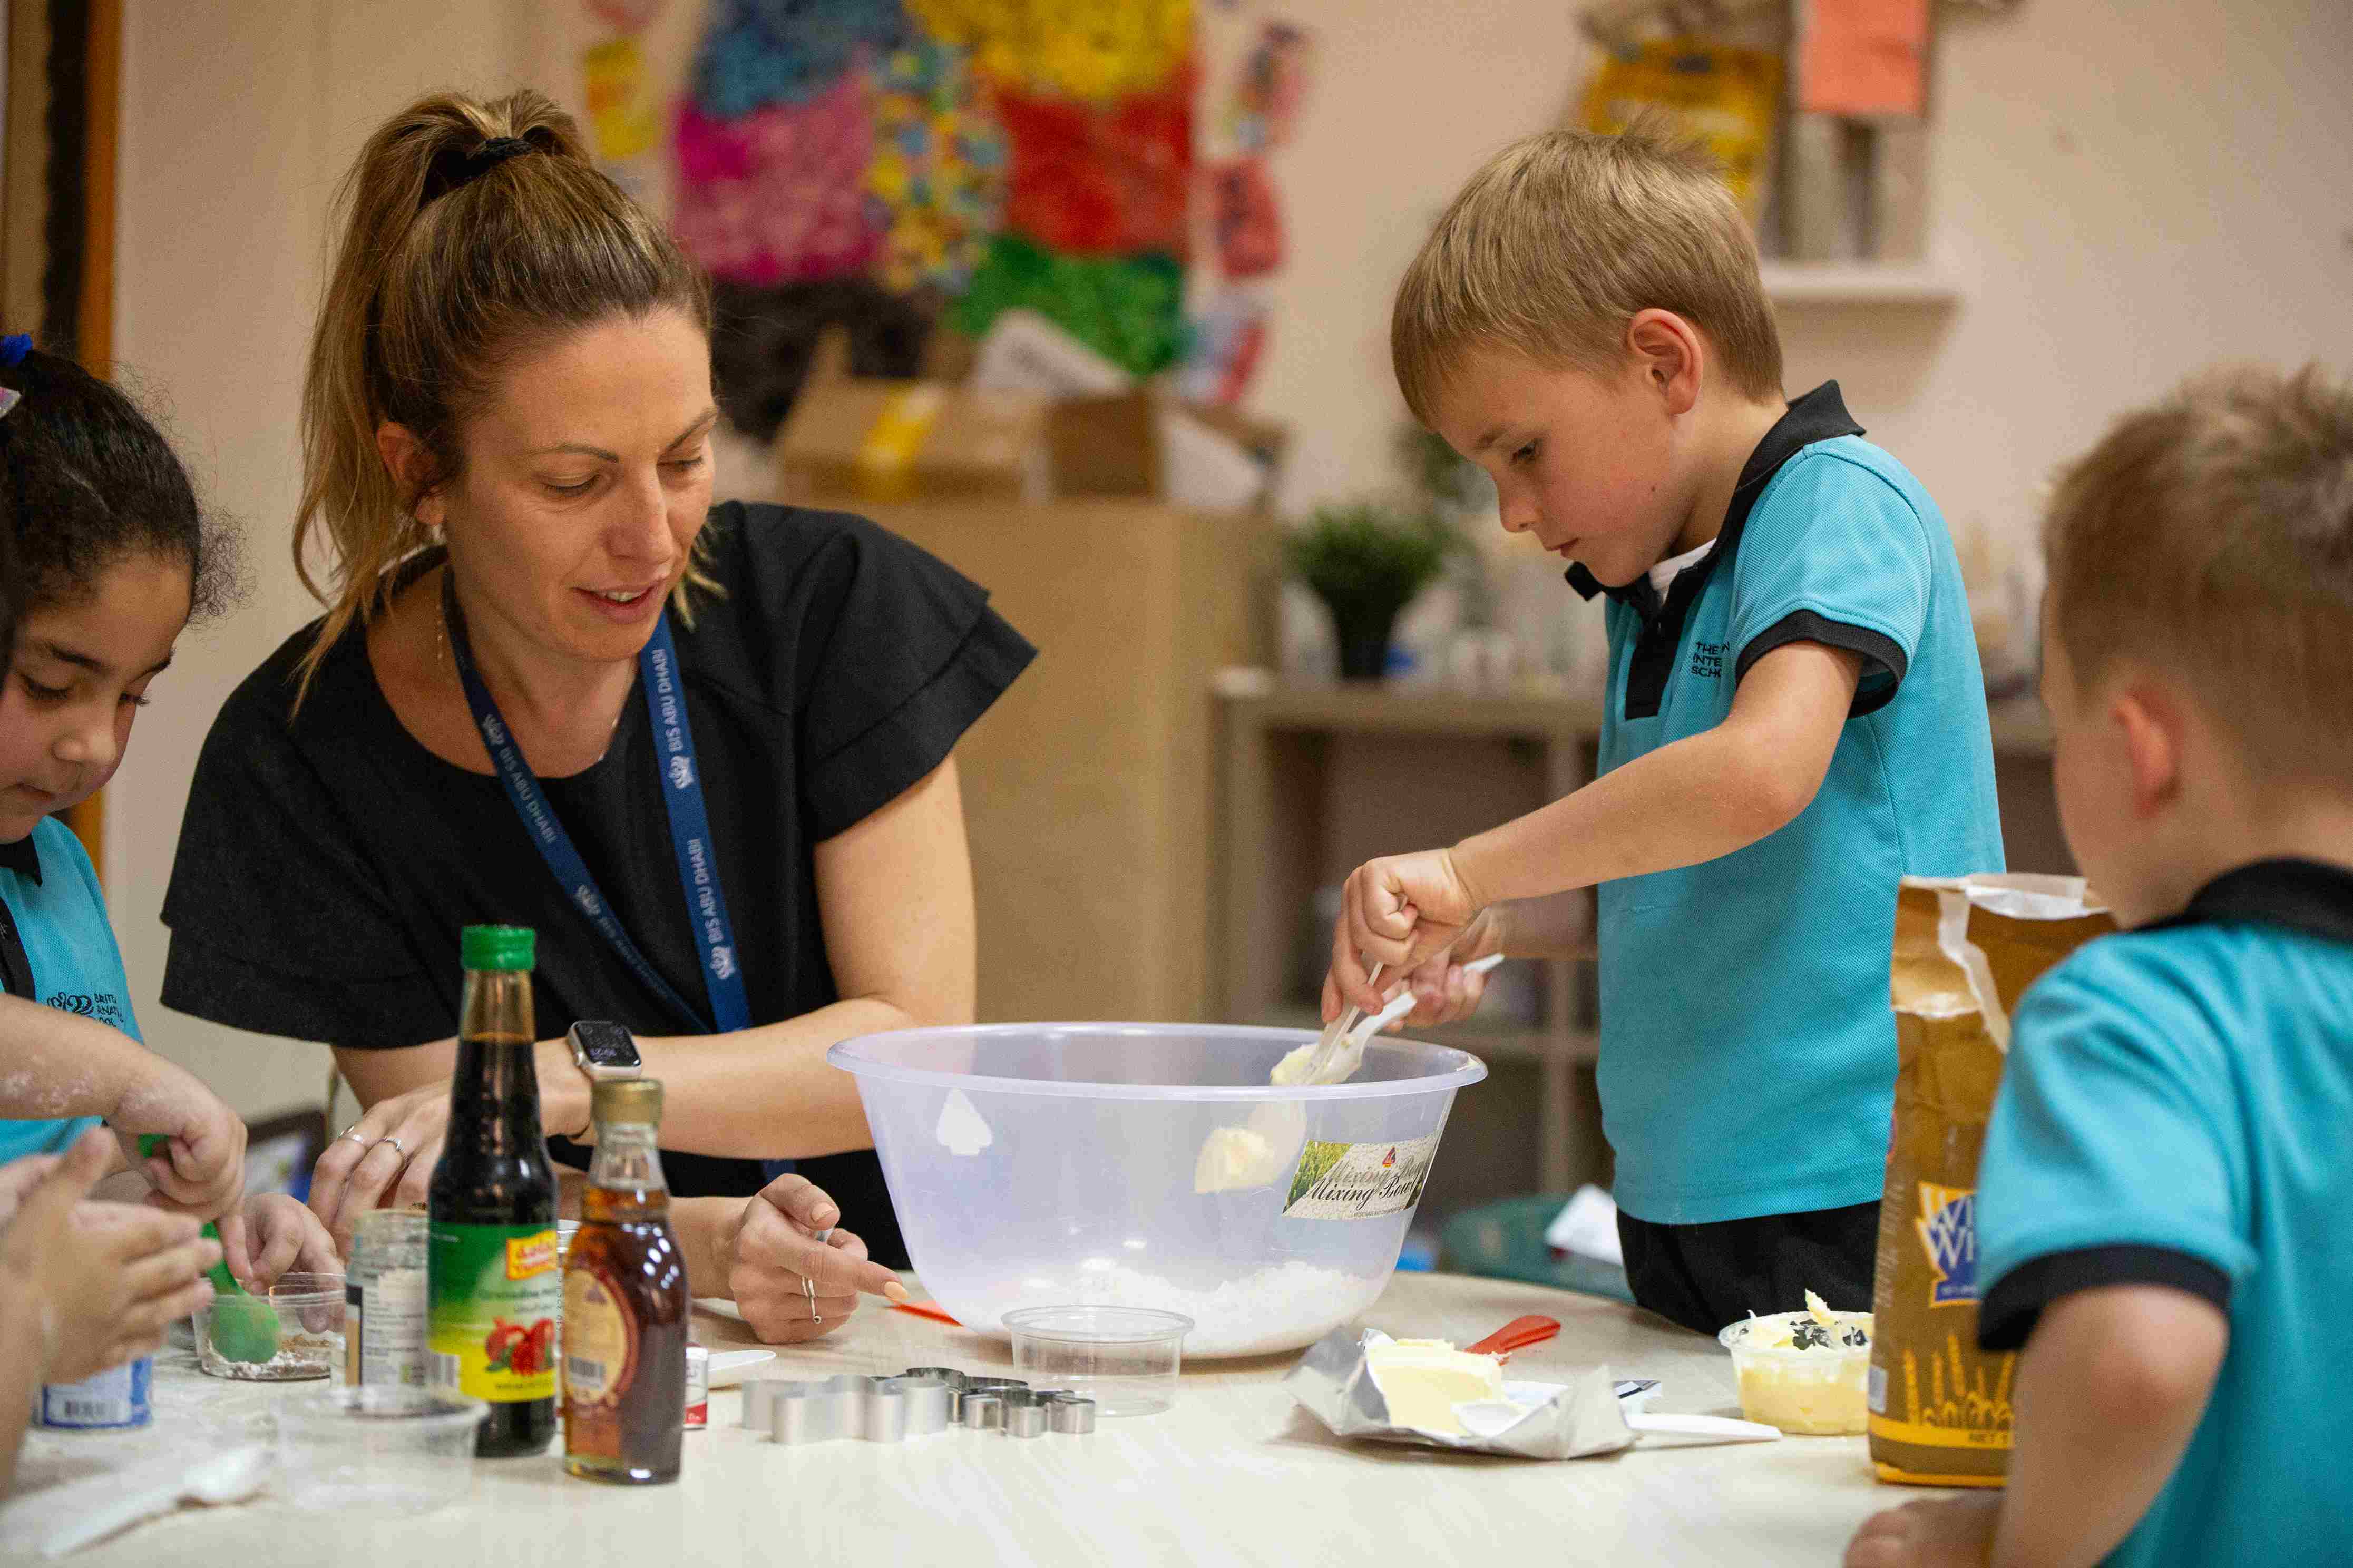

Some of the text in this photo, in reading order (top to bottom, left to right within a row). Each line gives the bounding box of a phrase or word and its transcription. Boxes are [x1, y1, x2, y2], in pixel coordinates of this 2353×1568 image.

[1696, 641, 1719, 655] THE
[1303, 1177, 1374, 1211] Mixing
[1379, 1173, 1420, 1199] Bowl
